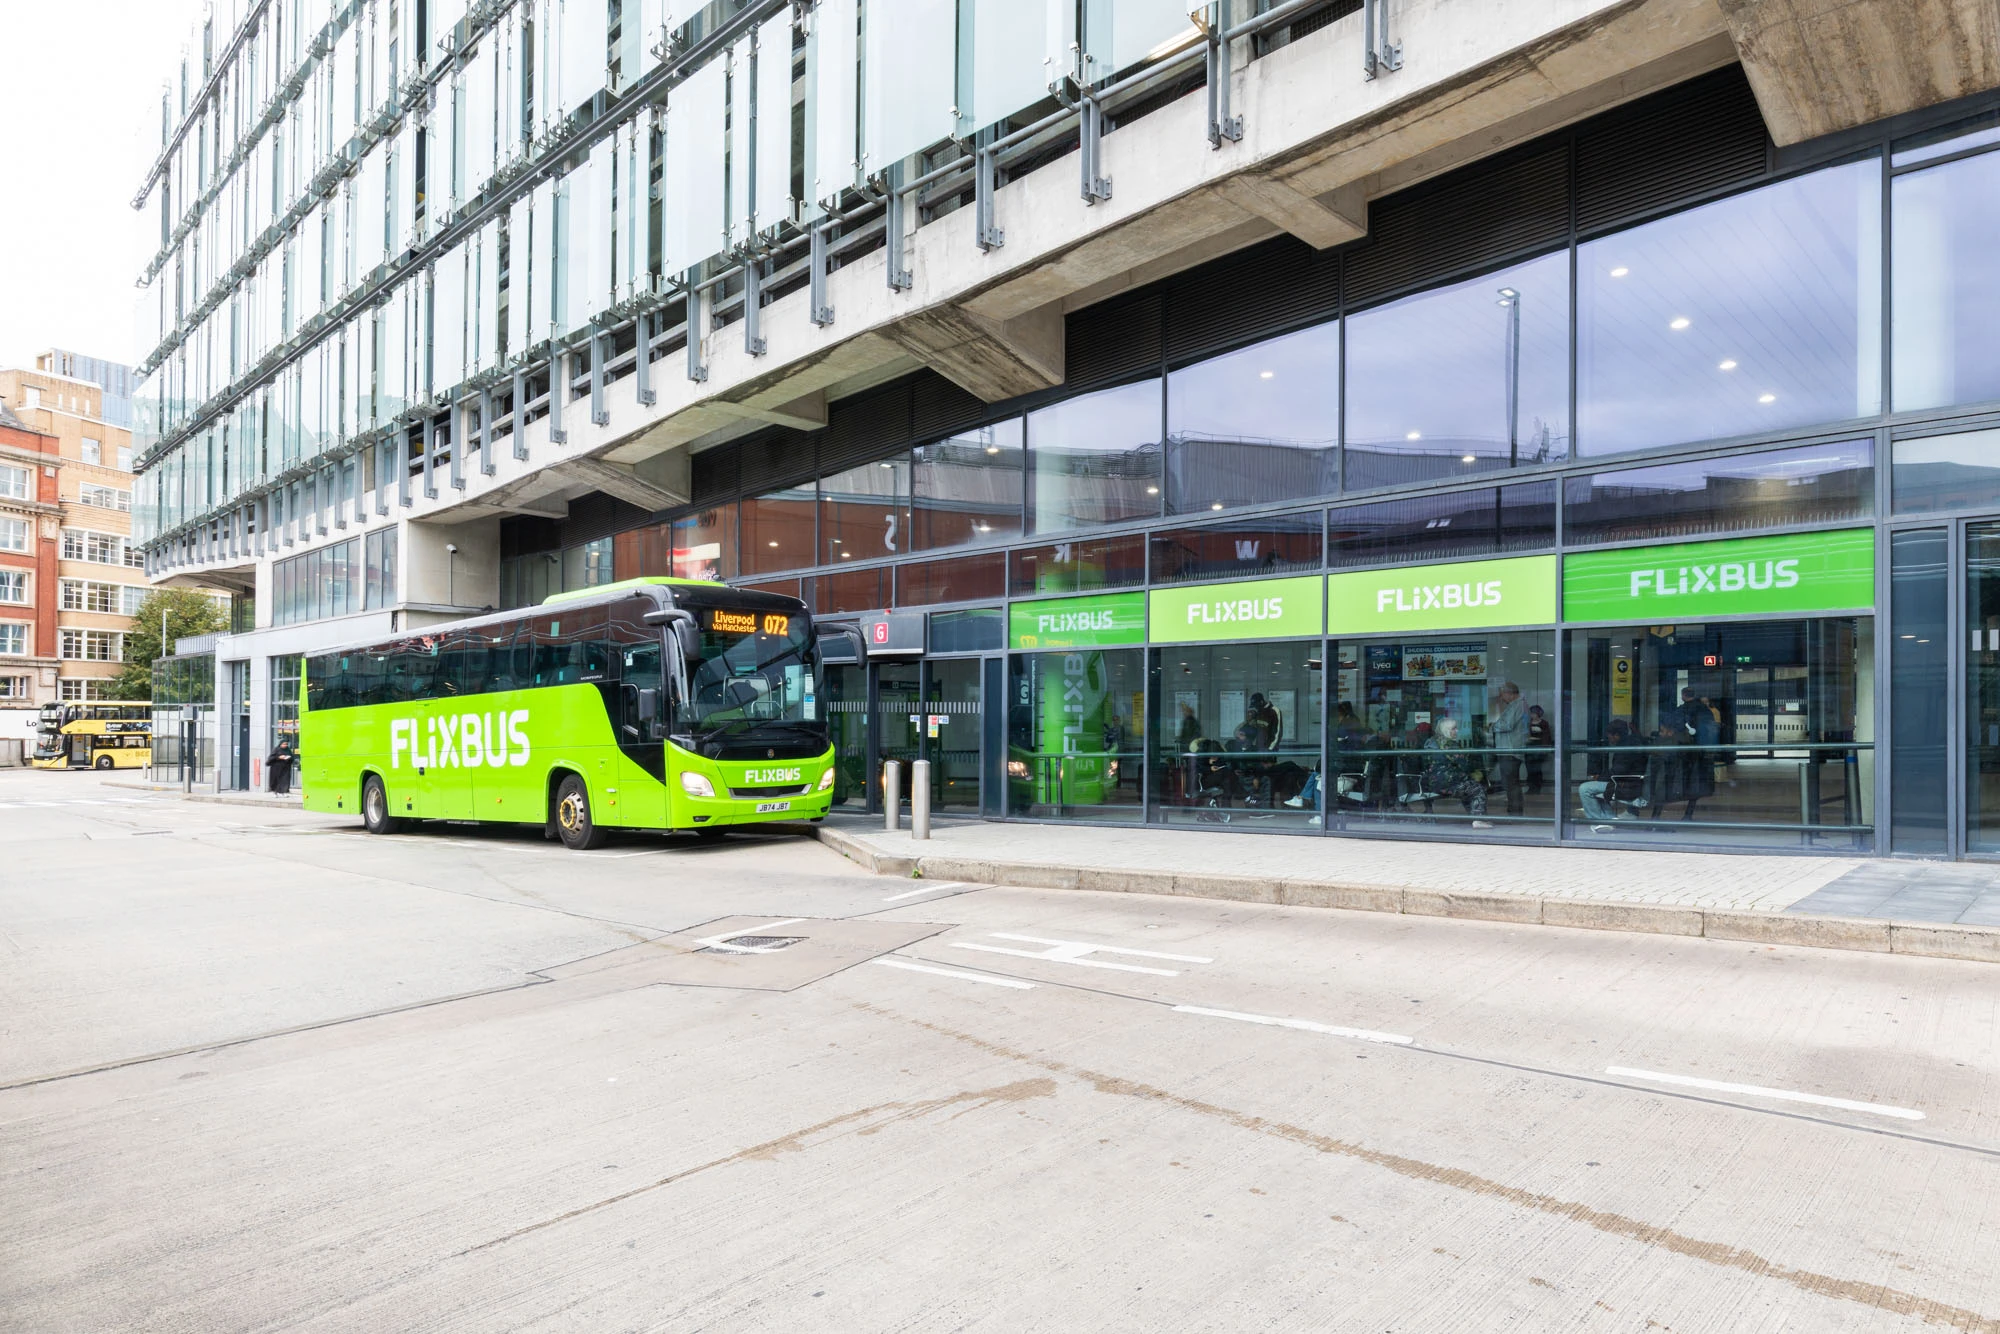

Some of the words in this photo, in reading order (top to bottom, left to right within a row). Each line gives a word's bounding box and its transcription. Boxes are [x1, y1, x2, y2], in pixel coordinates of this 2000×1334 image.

[1630, 559, 1800, 597] FLiXBUS
[1377, 580, 1502, 613] FLiXBUS
[714, 610, 755, 625] Liverpool
[1187, 597, 1283, 624] FLiXBUS
[722, 623, 757, 633] Manchester
[764, 615, 788, 636] 072
[1038, 610, 1113, 633] FLiXBUS
[876, 626, 884, 640] G
[390, 709, 531, 769] FLiXBUS
[745, 767, 801, 783] FLiXBUS
[759, 804, 775, 812] JB74
